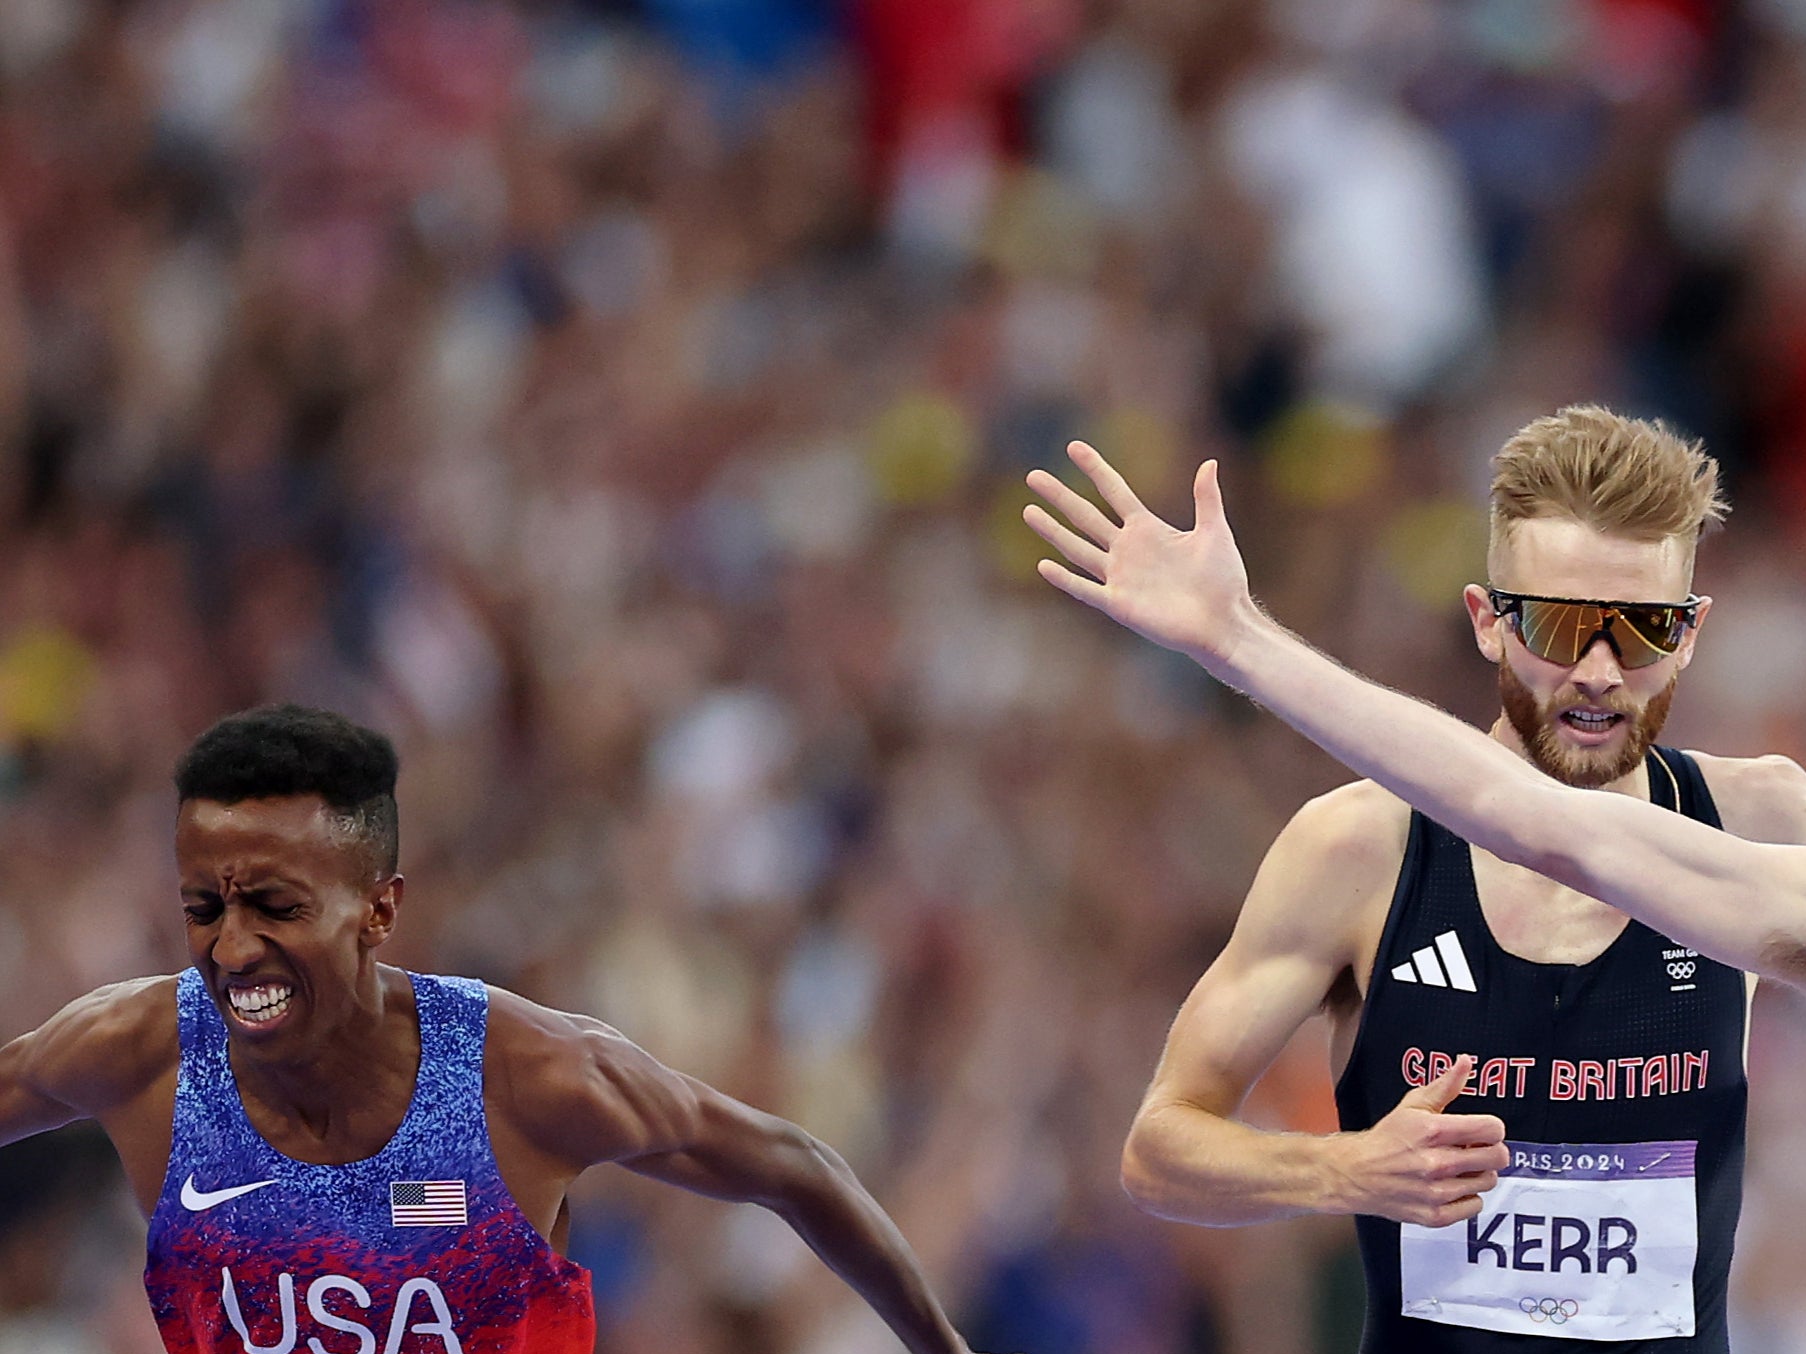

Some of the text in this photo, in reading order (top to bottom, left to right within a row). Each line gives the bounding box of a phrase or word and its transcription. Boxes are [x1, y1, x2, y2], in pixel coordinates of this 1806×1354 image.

[1662, 949, 1685, 959] TEAM
[1550, 1050, 1709, 1100] BRITAIN
[1561, 1153, 1625, 1171] 2024
[1467, 1212, 1638, 1274] KERR
